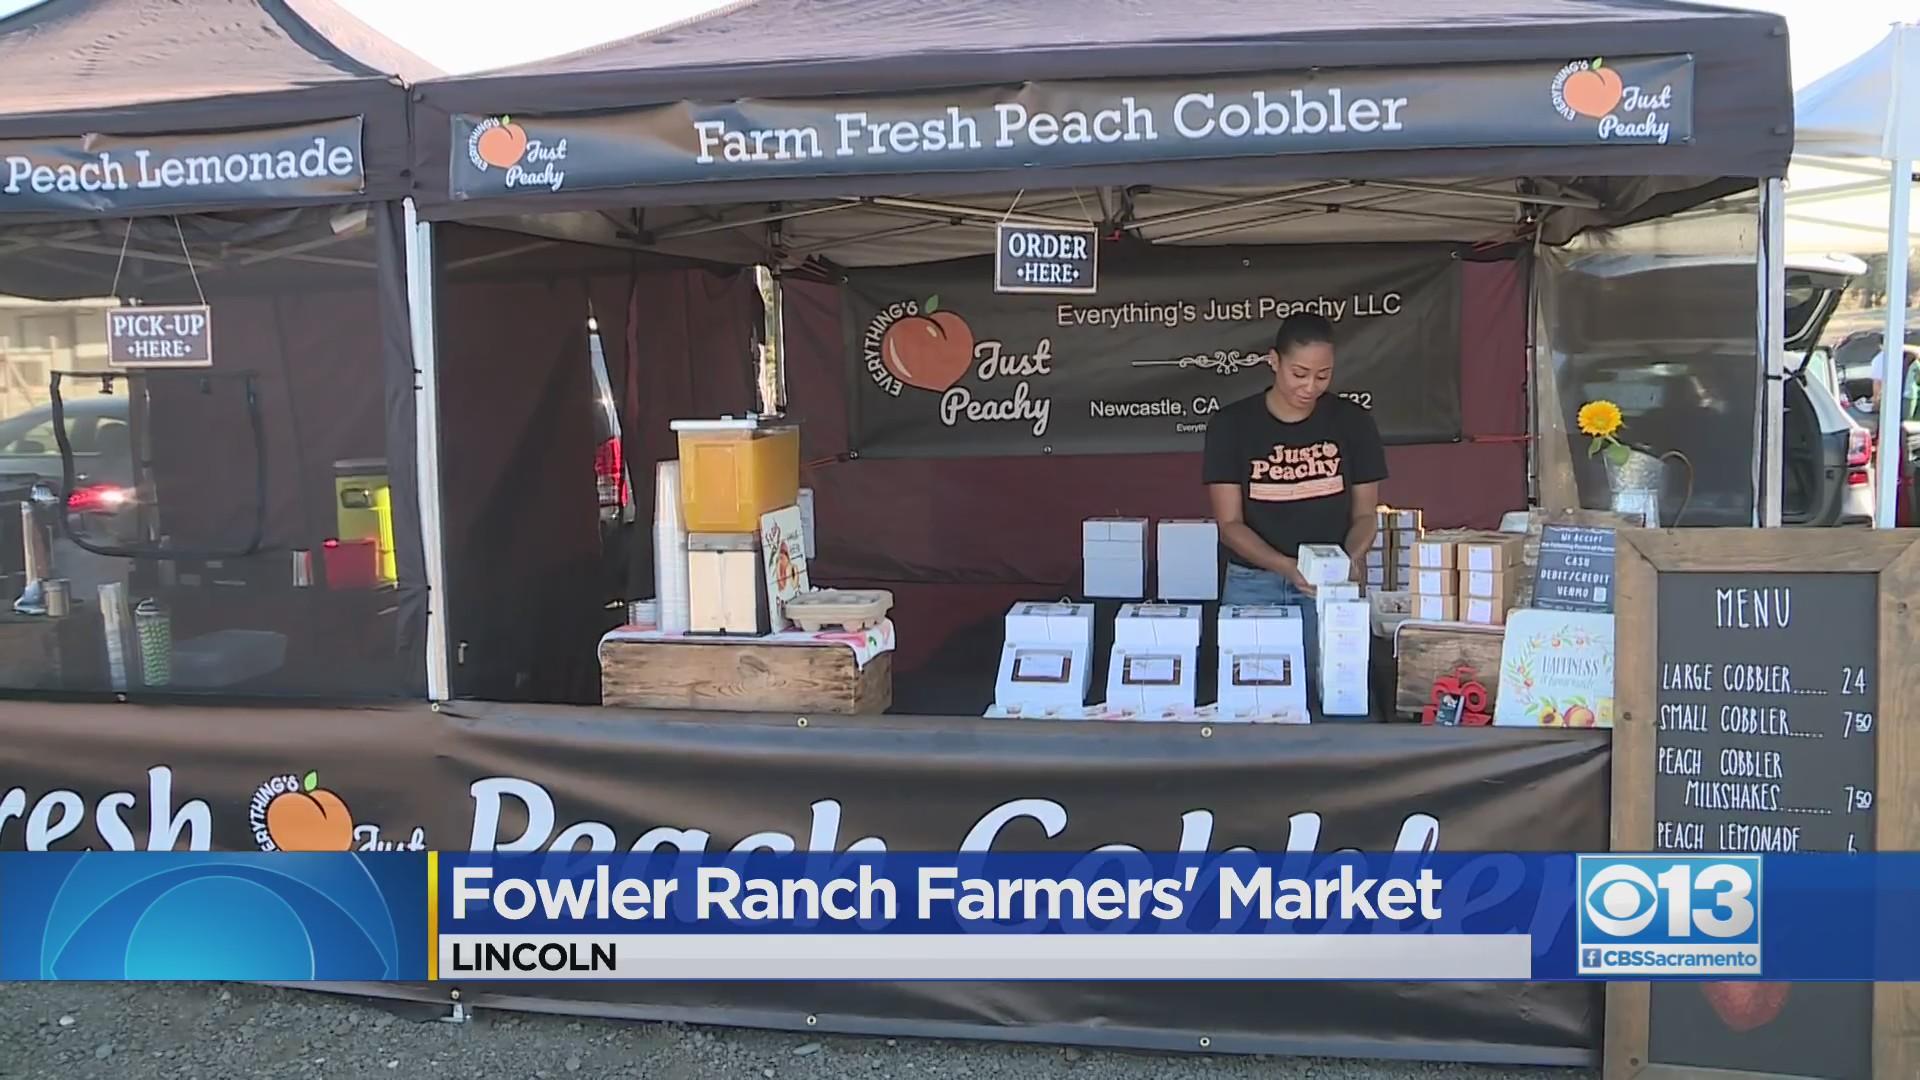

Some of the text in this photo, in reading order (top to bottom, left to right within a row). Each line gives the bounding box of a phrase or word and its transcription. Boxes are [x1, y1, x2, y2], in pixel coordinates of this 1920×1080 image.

[1623, 84, 1671, 111] Just
[694, 88, 1408, 165] Farm Fresh Peach Cobbler
[1598, 111, 1670, 144] Peachy
[526, 138, 567, 163] Just
[4, 138, 354, 194] Peach Lemonade
[505, 162, 565, 192] Peachy
[1008, 232, 1088, 260] ORDER
[113, 314, 205, 337] PICK-UP
[1057, 293, 1401, 328] Everything's Just Peachy LLC
[864, 301, 918, 397] EVERYTHING'S
[973, 338, 1052, 380] Just
[940, 381, 1052, 437] Peachy
[1090, 398, 1188, 418] Newcastle,
[1192, 397, 1220, 415] CA
[1251, 458, 1341, 480] Peachy
[1268, 444, 1323, 464] Just
[1565, 555, 1590, 568] CASH
[1540, 569, 1610, 585] DEBIT/CREDIT
[1557, 586, 1589, 598] VENMO
[1715, 587, 1792, 629] MENU
[1663, 663, 1713, 692] LARGE
[1842, 667, 1866, 695] 24
[1660, 704, 1709, 732] SMALL
[1658, 748, 1783, 779] PEACH COBBLER
[0, 766, 213, 852] resh
[249, 775, 299, 852] ERYTHING'S
[1657, 822, 1705, 851] PEACH
[1720, 823, 1801, 852] LEMONADE
